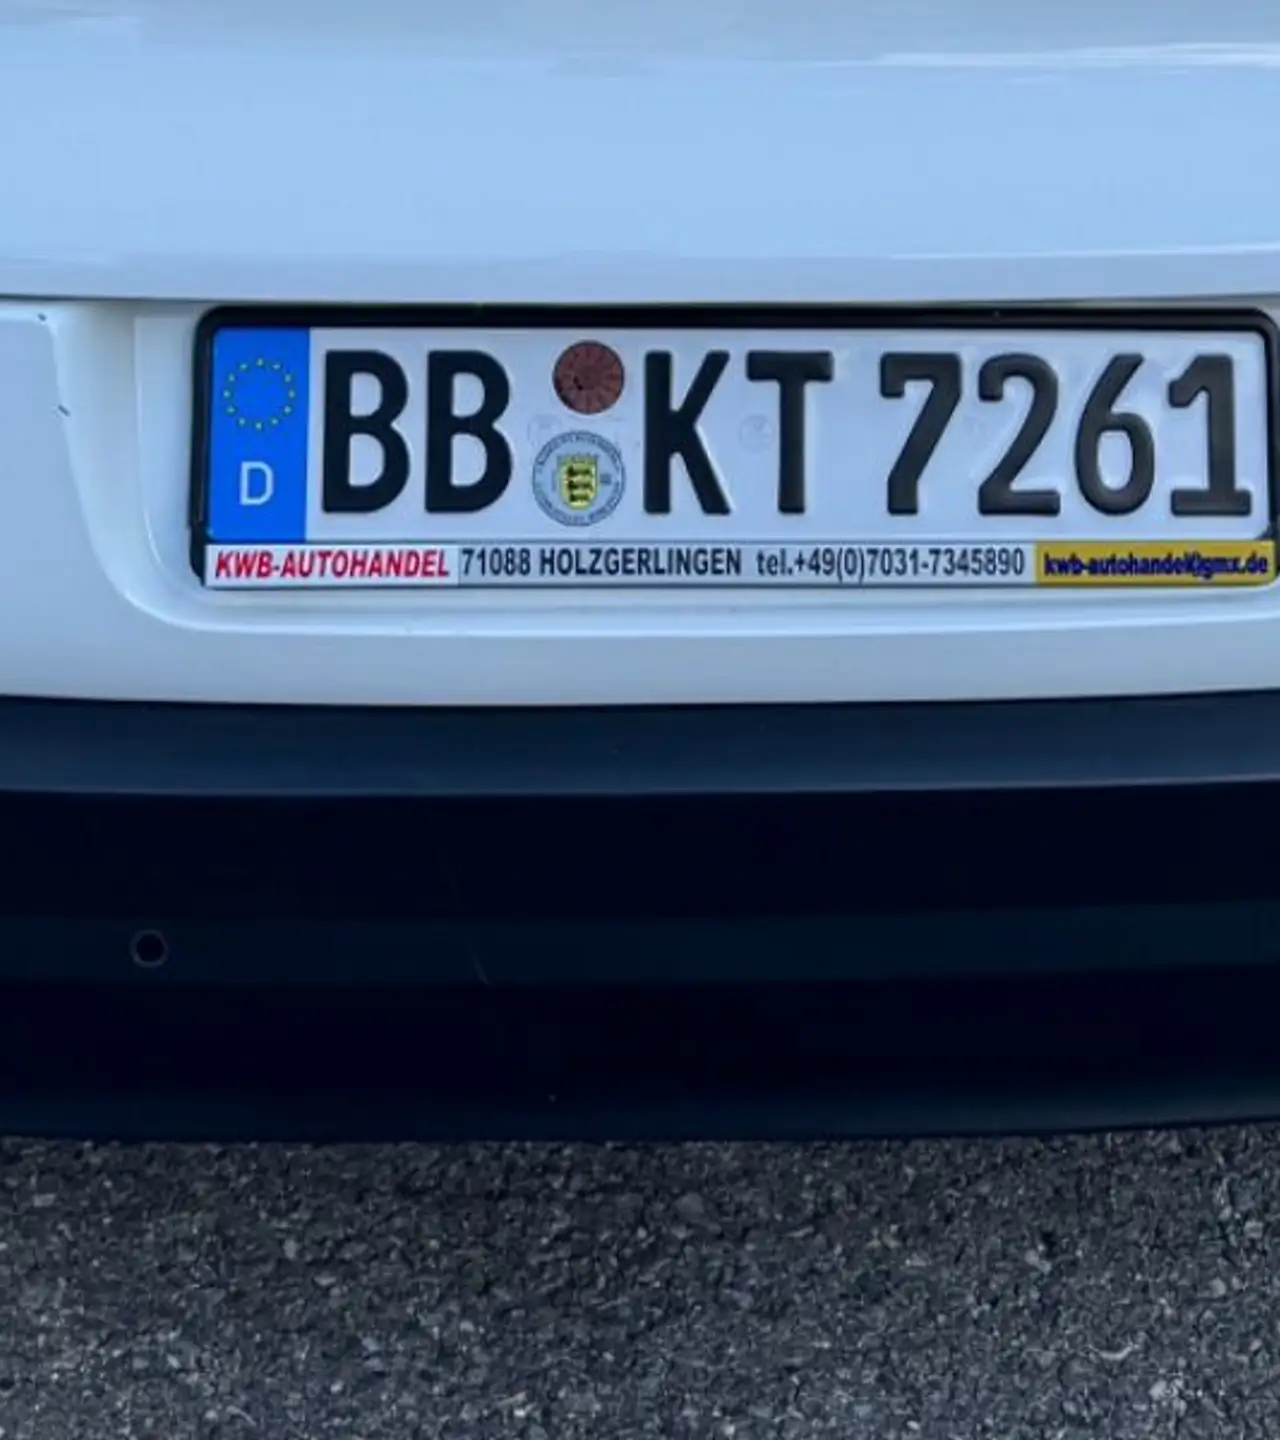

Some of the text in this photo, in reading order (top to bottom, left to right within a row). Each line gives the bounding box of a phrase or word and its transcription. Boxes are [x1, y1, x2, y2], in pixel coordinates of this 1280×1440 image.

[322, 350, 514, 514] BB
[642, 350, 834, 515] KT
[879, 352, 1252, 517] 7261
[239, 461, 275, 506] D
[215, 548, 449, 579] KWB-AUTOHANDEL
[462, 548, 531, 576] 71088
[539, 548, 741, 576] HOLZGERLINGEN
